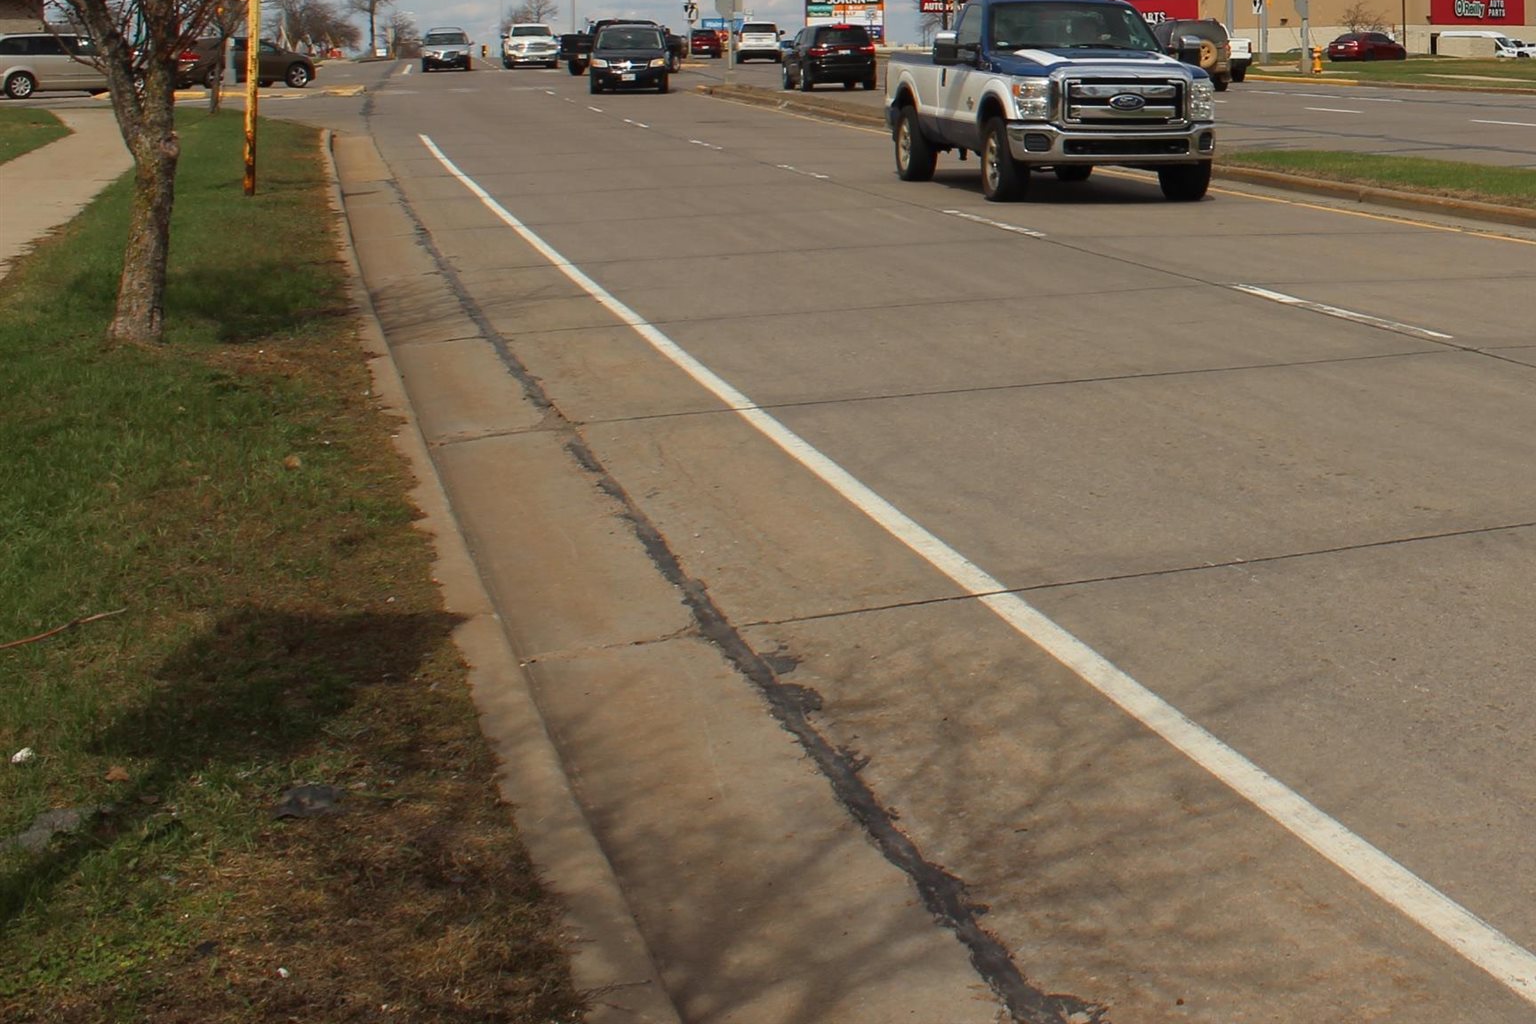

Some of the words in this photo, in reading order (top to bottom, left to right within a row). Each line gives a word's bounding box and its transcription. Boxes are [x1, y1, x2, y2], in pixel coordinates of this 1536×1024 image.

[1490, 0, 1504, 8] AUTO
[1142, 11, 1166, 23] ARTS
[1488, 8, 1505, 17] PARTS
